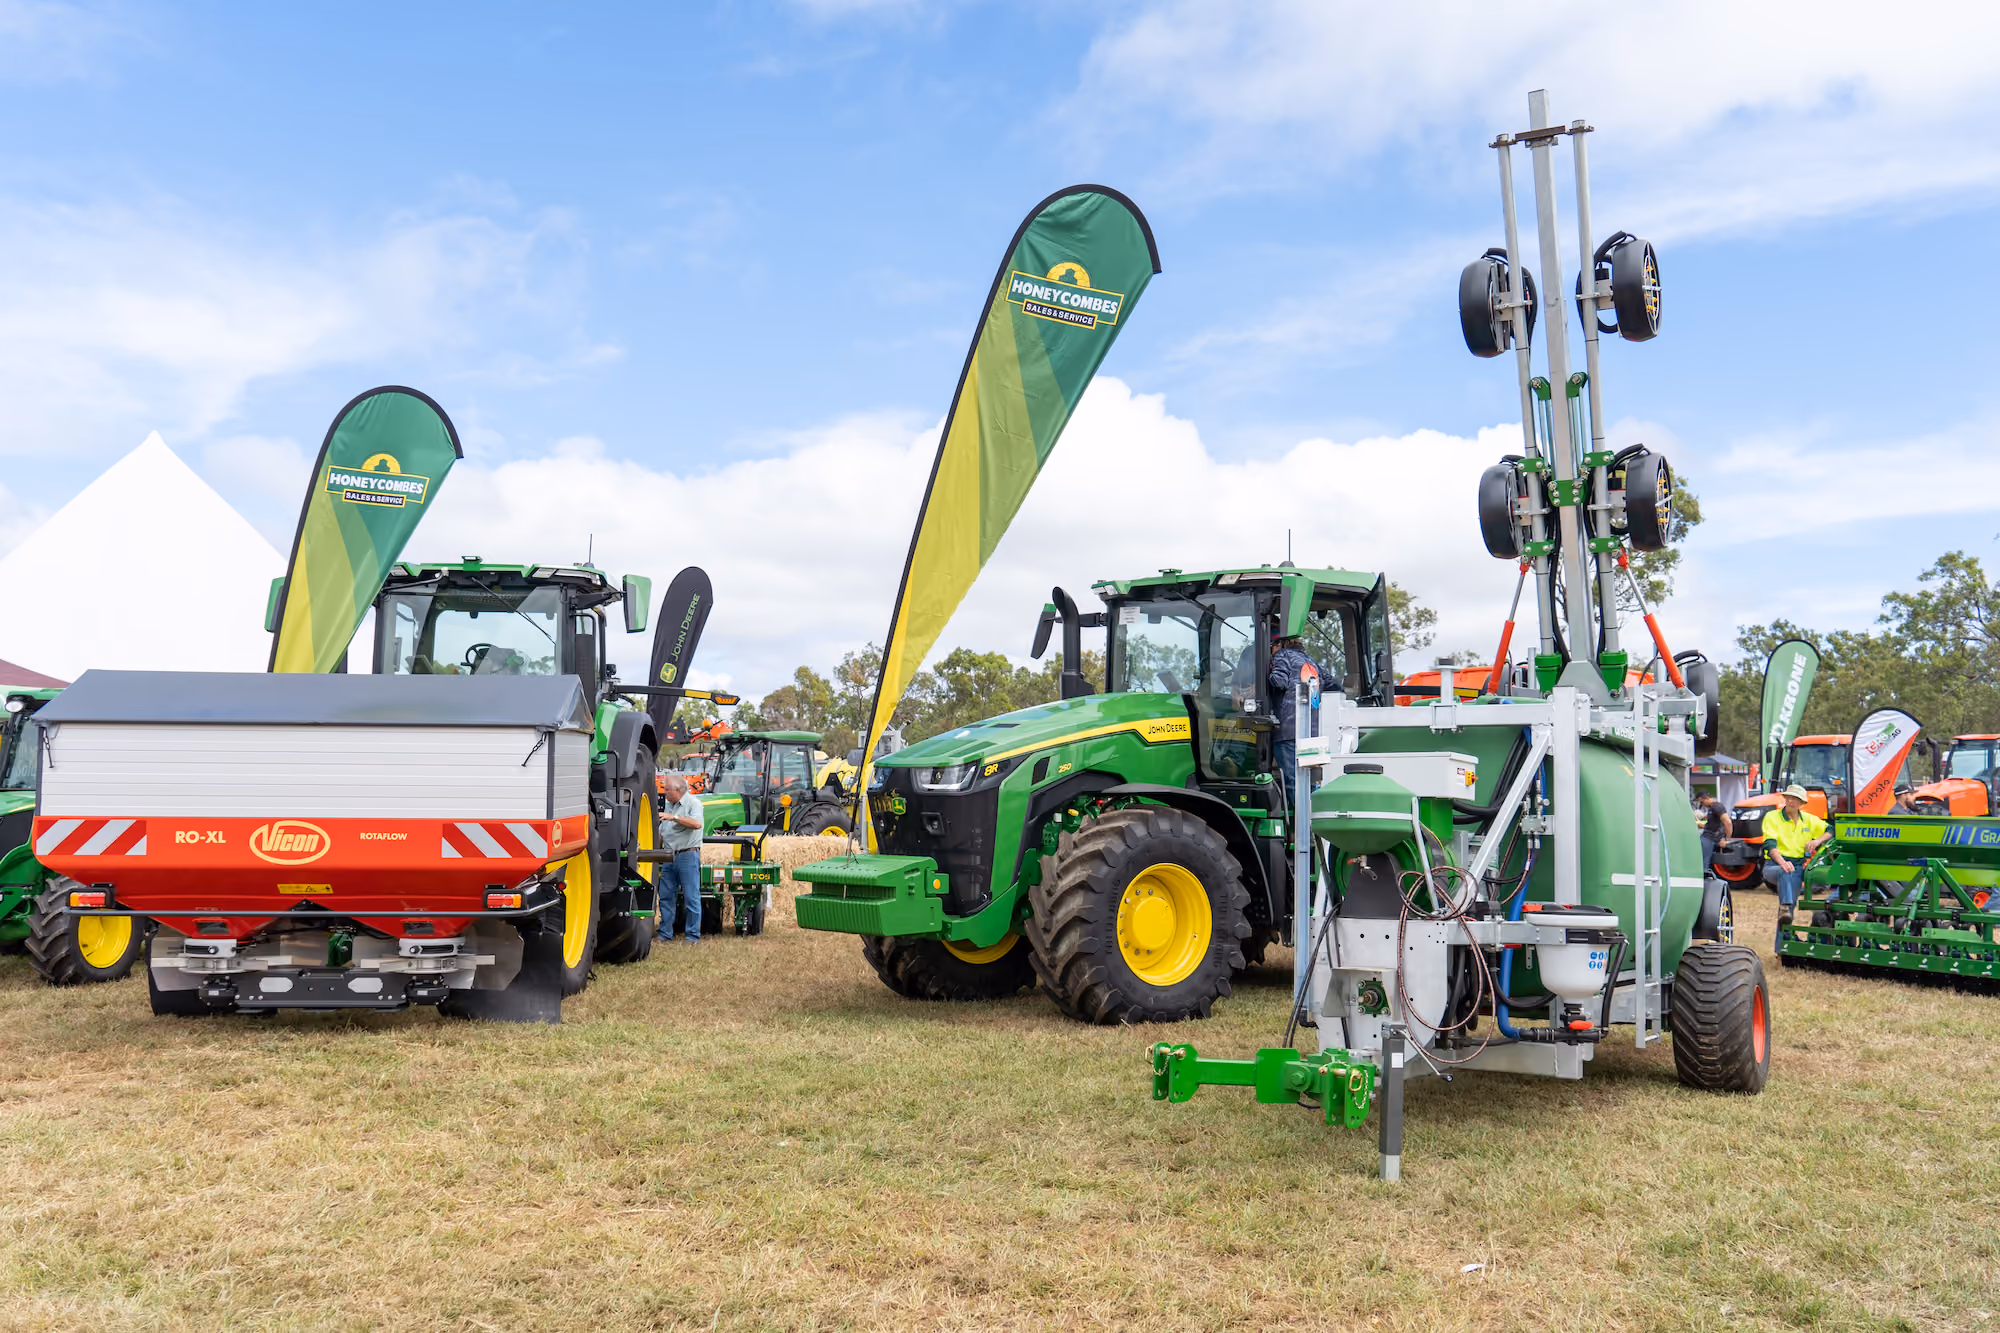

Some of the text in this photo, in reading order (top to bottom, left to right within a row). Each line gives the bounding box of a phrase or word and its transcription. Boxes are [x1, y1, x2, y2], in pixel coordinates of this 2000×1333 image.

[1011, 279, 1119, 315] HONEYCOMBES
[329, 472, 424, 494] HONEYCOMBES
[671, 593, 700, 662] JOHN DEERE
[1779, 652, 1807, 726] KRONE
[1148, 723, 1188, 734] JOHN DEERE
[984, 763, 998, 776] 8R
[175, 830, 227, 844] RO-XL
[259, 822, 320, 852] Vicon
[359, 832, 408, 841] ROTAFLOW
[1844, 827, 1901, 839] AITCHISON
